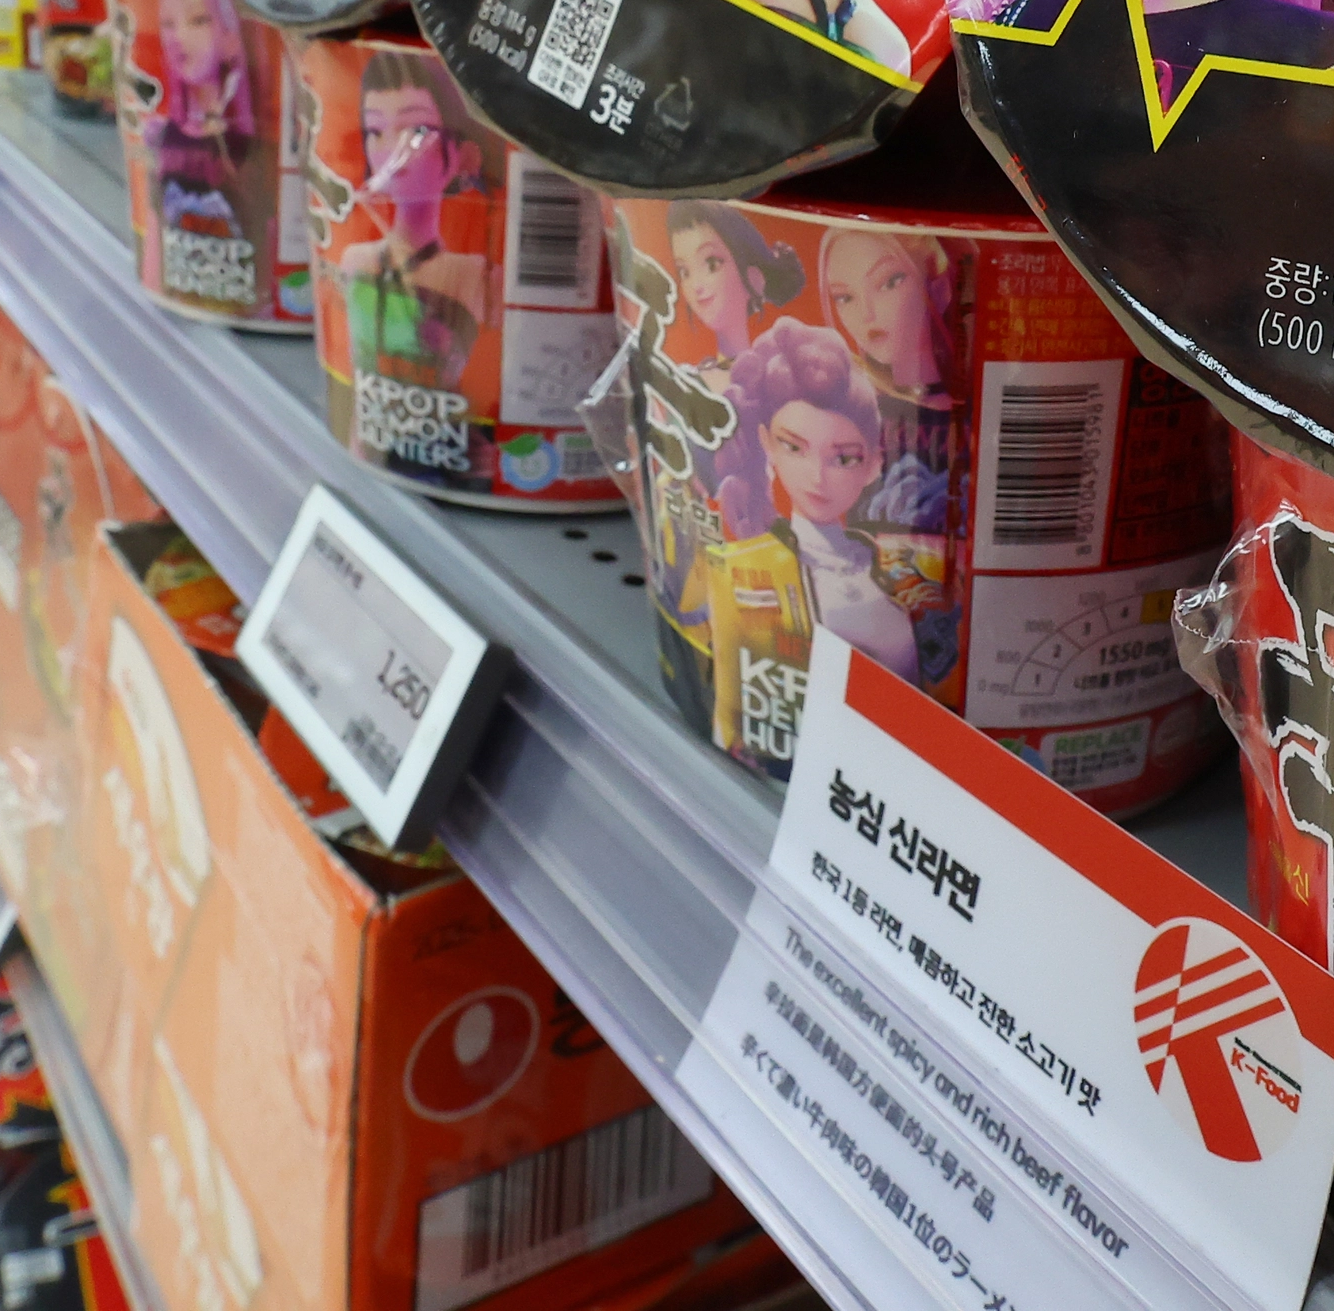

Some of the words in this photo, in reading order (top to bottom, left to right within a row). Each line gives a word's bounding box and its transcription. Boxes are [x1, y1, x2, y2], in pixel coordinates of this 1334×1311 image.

[590, 83, 635, 135] 3분
[1257, 307, 1326, 357] (500
[1099, 641, 1144, 666] 1550
[829, 768, 886, 846] 농심
[888, 817, 982, 923] 신라면
[811, 850, 842, 895] 한국
[845, 878, 870, 916] 1등
[870, 901, 904, 952] 라면,
[908, 934, 977, 1011] 매콤하고
[976, 992, 1017, 1045] 진한
[1015, 1030, 1077, 1096] 소고기
[1077, 1077, 1102, 1118] 맛
[786, 926, 815, 969] The
[814, 959, 890, 1039] excellent
[887, 1027, 936, 1085] spicy
[934, 1071, 974, 1117] and
[971, 1107, 1011, 1155] rich
[1011, 1138, 1066, 1196] beef
[1065, 1185, 1130, 1261] flavor
[1231, 1047, 1301, 1115] K-Food
[740, 1032, 1017, 1311] 辛くて濃い牛肉味の韓国1位のラーメ
